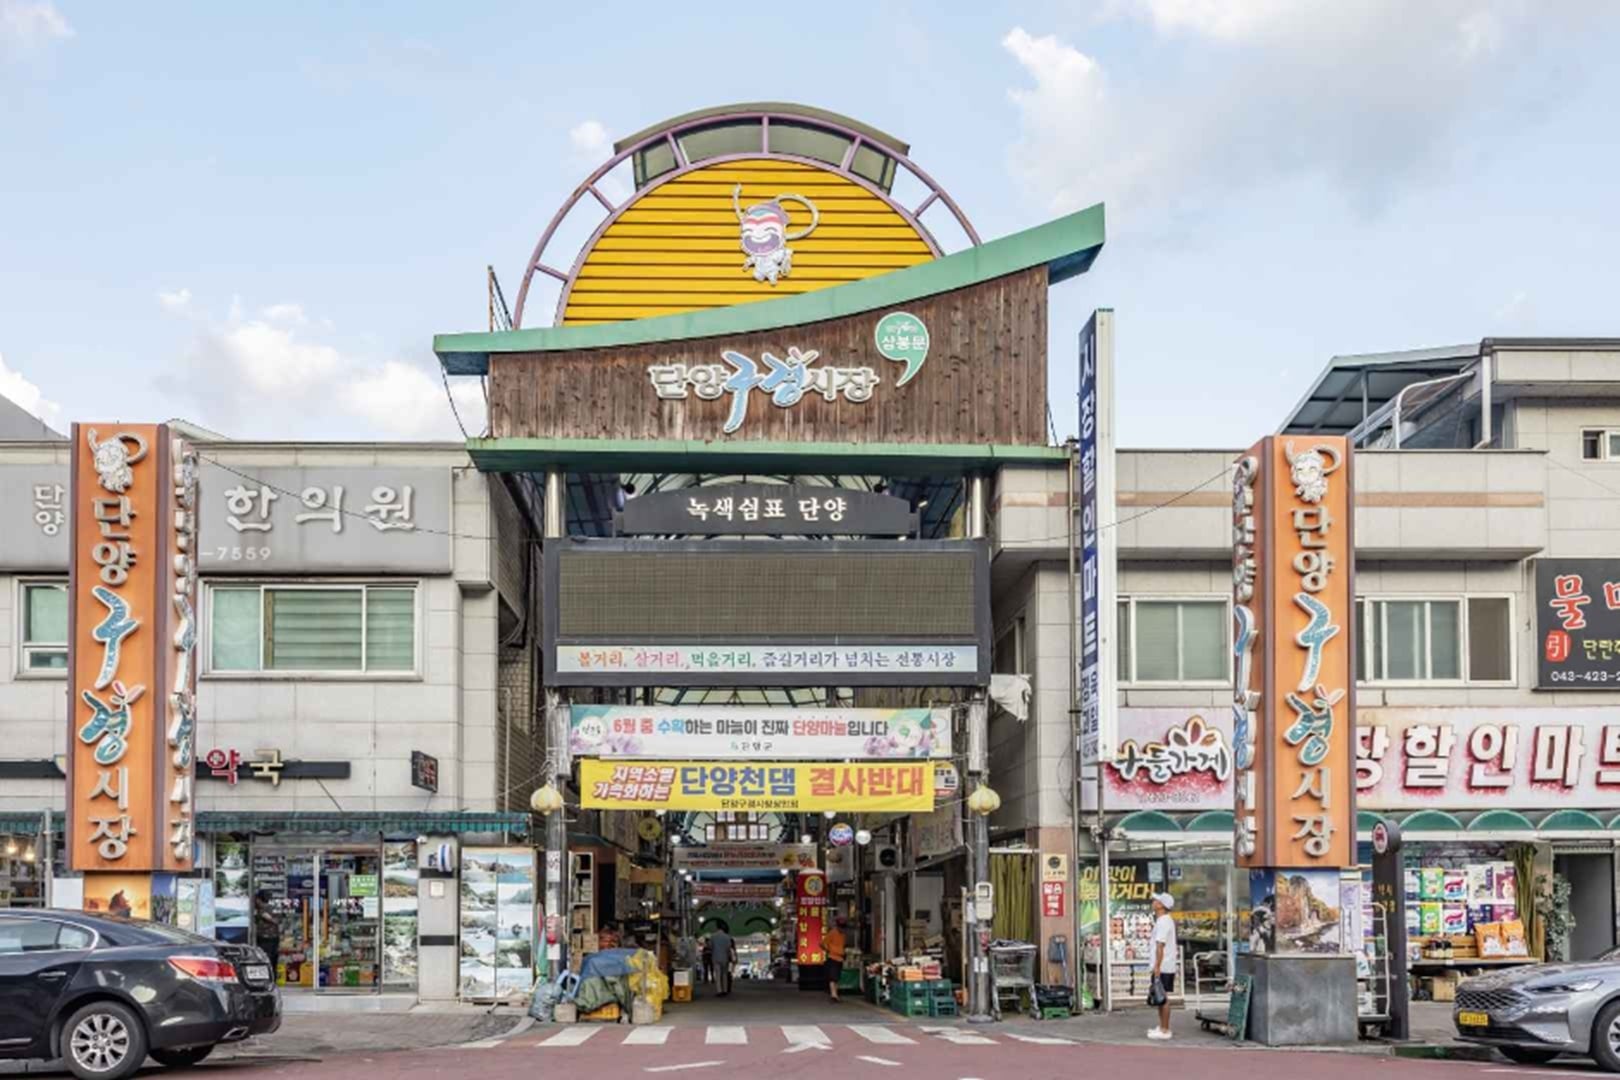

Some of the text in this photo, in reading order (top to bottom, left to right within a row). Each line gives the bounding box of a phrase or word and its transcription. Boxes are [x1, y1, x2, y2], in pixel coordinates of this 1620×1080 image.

[648, 347, 880, 434] 단양구경시장
[35, 484, 66, 537] 단양
[223, 485, 416, 534] 한의원
[686, 497, 848, 521] 녹색쉼표 단양
[80, 496, 146, 861] 단양구경시장
[763, 651, 839, 667] 즐길거리가
[845, 651, 890, 667] 넘치는
[895, 651, 956, 667] 전통시장
[1283, 505, 1347, 858] 단양구경시장
[613, 718, 636, 734] 6월
[716, 719, 757, 736] 마늘이
[761, 719, 789, 736] 진짜
[792, 720, 889, 737] 단양마늘입니다
[206, 748, 285, 786] 약국
[680, 766, 796, 797] 단양천댐
[808, 767, 925, 797] 결사반대
